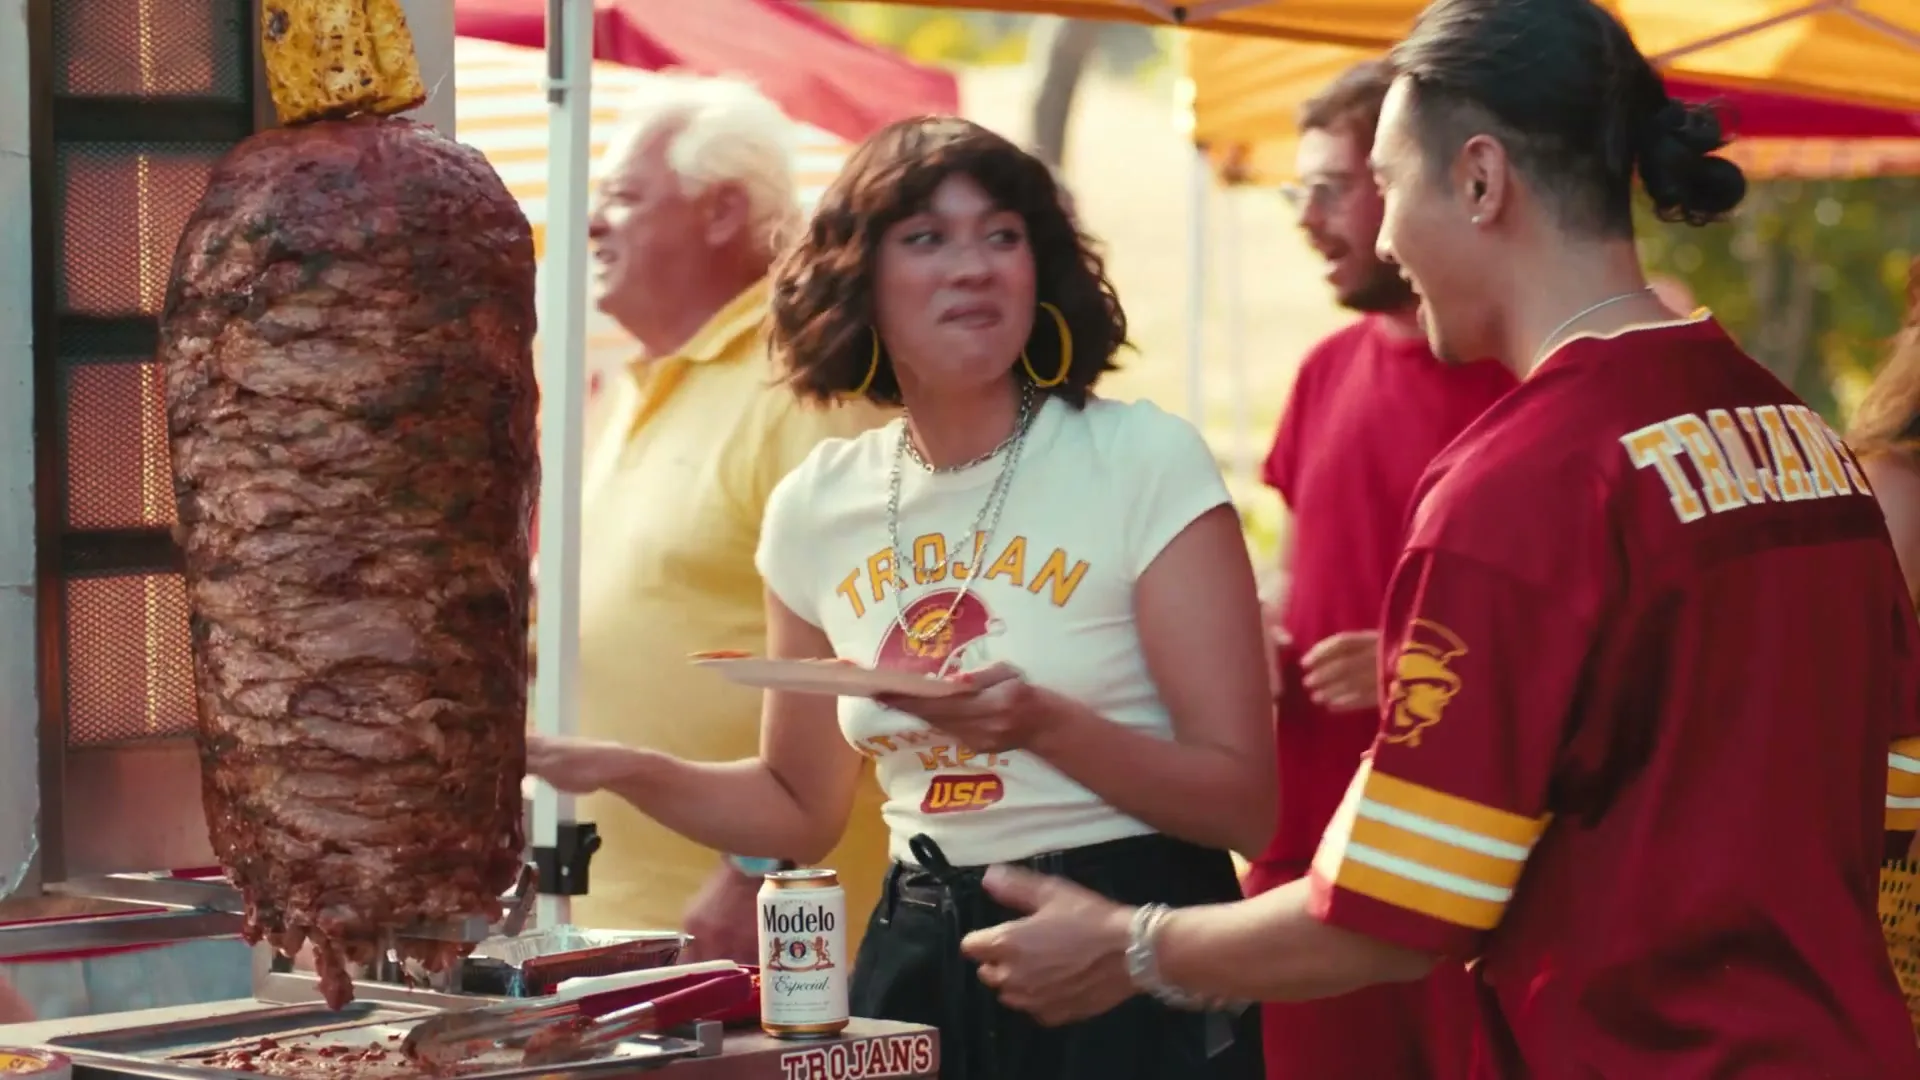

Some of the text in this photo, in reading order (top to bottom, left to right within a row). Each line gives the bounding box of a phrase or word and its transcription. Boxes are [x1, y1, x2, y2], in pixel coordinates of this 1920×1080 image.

[836, 530, 1091, 618] TROJAN
[930, 780, 998, 809] USC
[763, 904, 835, 933] Modelo
[774, 975, 829, 997] Especial
[781, 1034, 932, 1080] TROJANS
